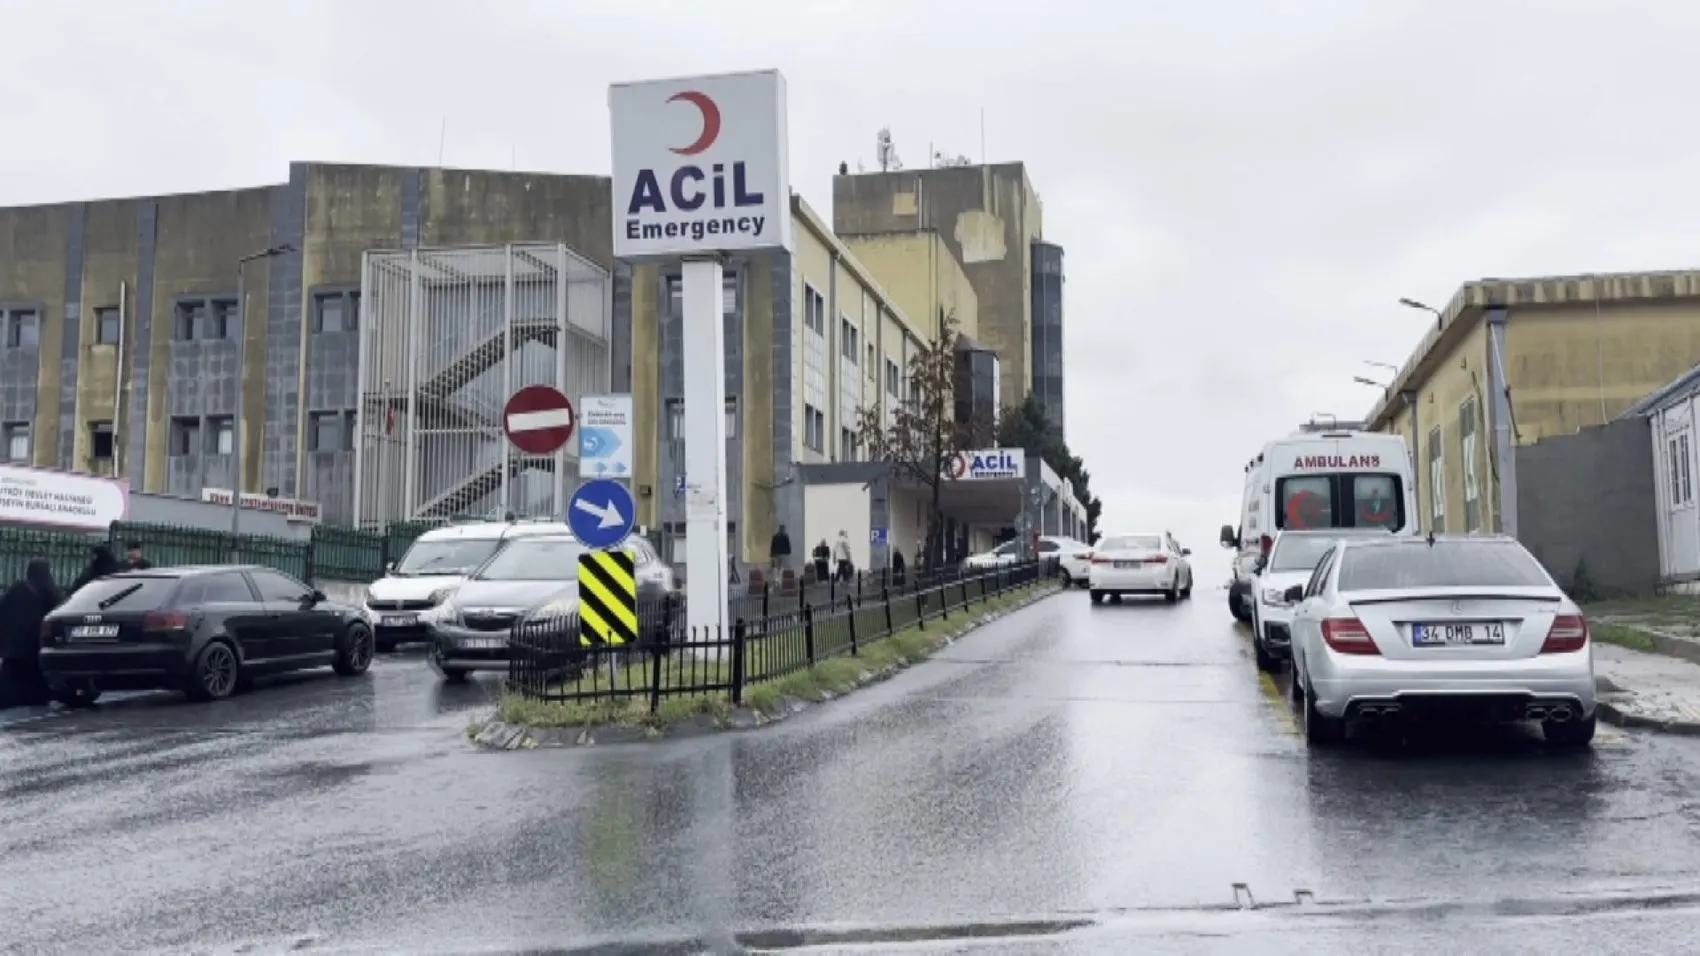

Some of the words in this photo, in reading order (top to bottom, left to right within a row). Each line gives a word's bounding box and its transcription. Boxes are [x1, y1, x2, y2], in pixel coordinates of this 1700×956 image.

[626, 215, 765, 240] Emergency
[1294, 455, 1380, 469] AMBULANS
[1423, 624, 1438, 640] 34
[1485, 624, 1501, 640] 14
